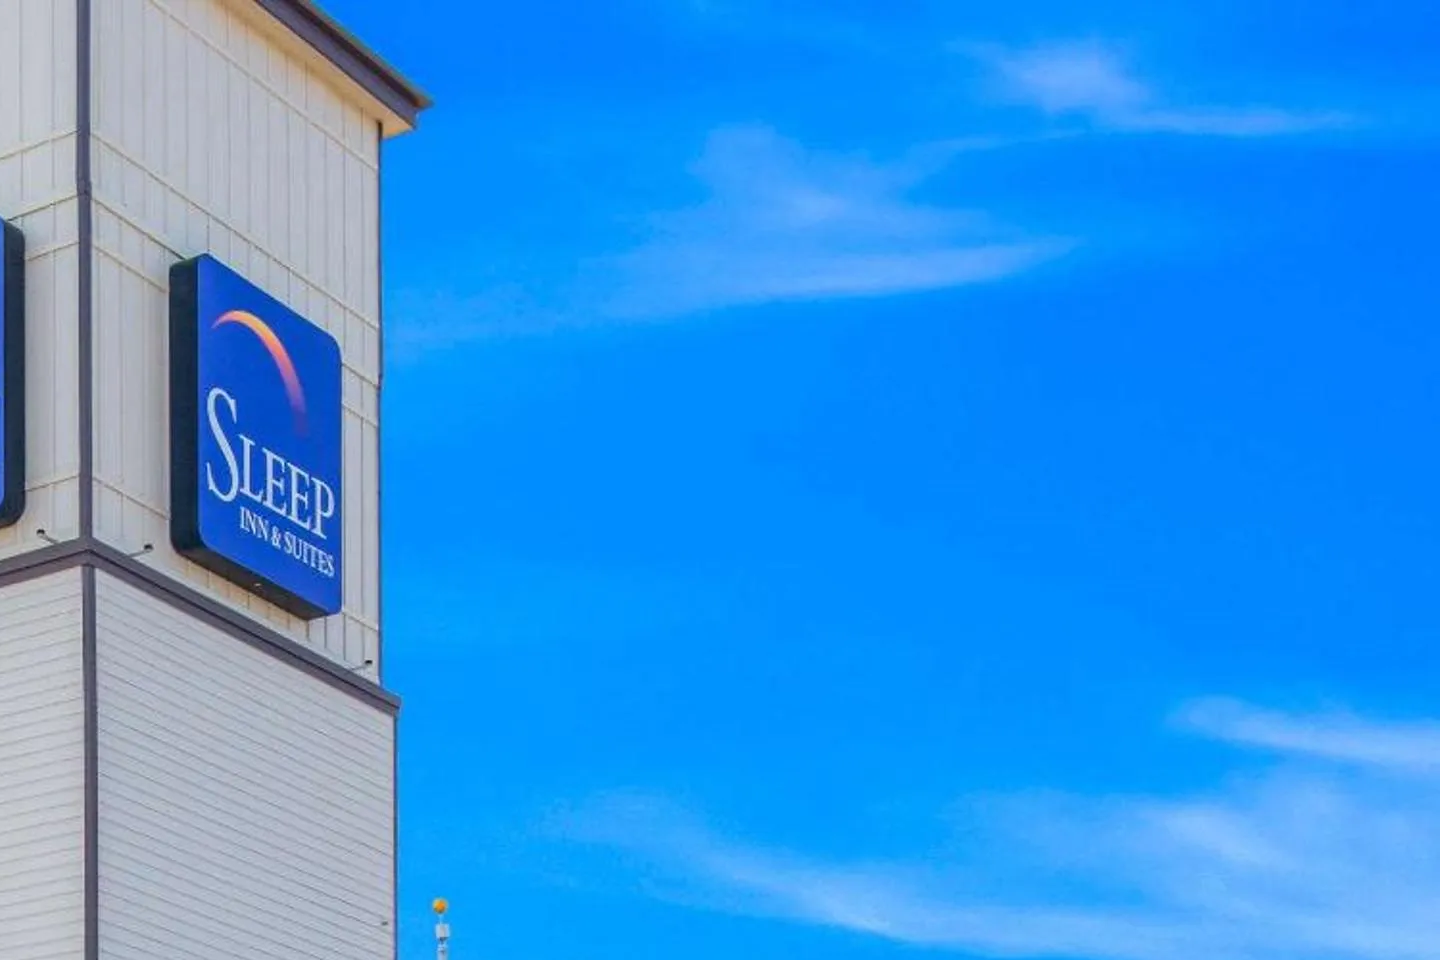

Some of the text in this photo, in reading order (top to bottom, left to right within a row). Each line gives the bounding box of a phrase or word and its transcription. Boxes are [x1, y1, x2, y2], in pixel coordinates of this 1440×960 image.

[207, 387, 335, 539] SLEEP
[240, 506, 335, 577] INN & SUITES
